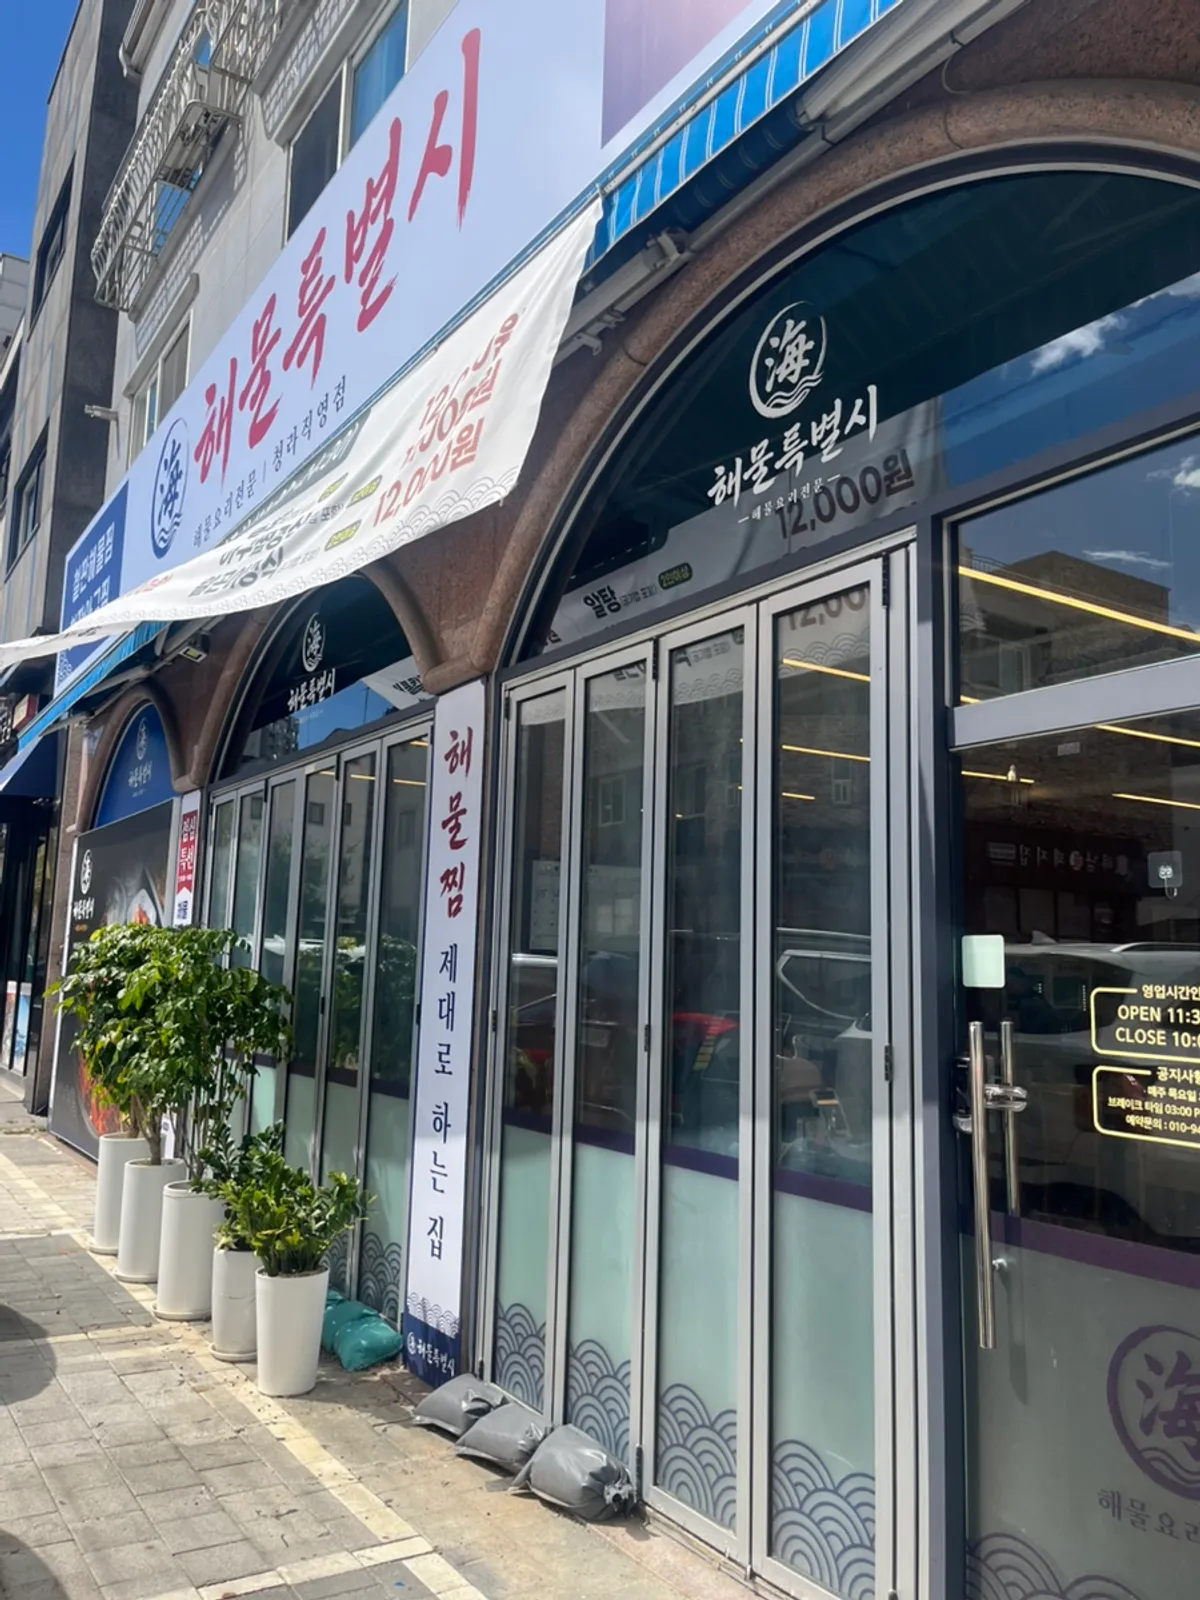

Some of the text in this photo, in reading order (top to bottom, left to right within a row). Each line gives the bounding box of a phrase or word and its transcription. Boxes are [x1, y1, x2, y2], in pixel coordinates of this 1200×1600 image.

[193, 27, 482, 492] 해물특별시
[766, 319, 815, 392] 海
[193, 468, 258, 548] 해물요리전문
[272, 375, 347, 473] 청라직영점
[706, 384, 878, 507] 해물특별시
[752, 478, 823, 520] 해물요리전문
[774, 447, 915, 540] 12,000원
[287, 667, 336, 712] 해물특별시
[427, 725, 474, 1260] 해물찜 제대로 하는 집
[1117, 1004, 1200, 1025] OPEN 11:3
[1115, 1026, 1200, 1048] CLOSE 10:
[1107, 1096, 1143, 1111] 브레이크
[1144, 1100, 1164, 1115] 타임
[1165, 1104, 1192, 1117] 03:00
[1168, 1087, 1197, 1102] 목요일
[1125, 1114, 1162, 1130] 예약문의
[416, 1338, 455, 1378] 해물특별시
